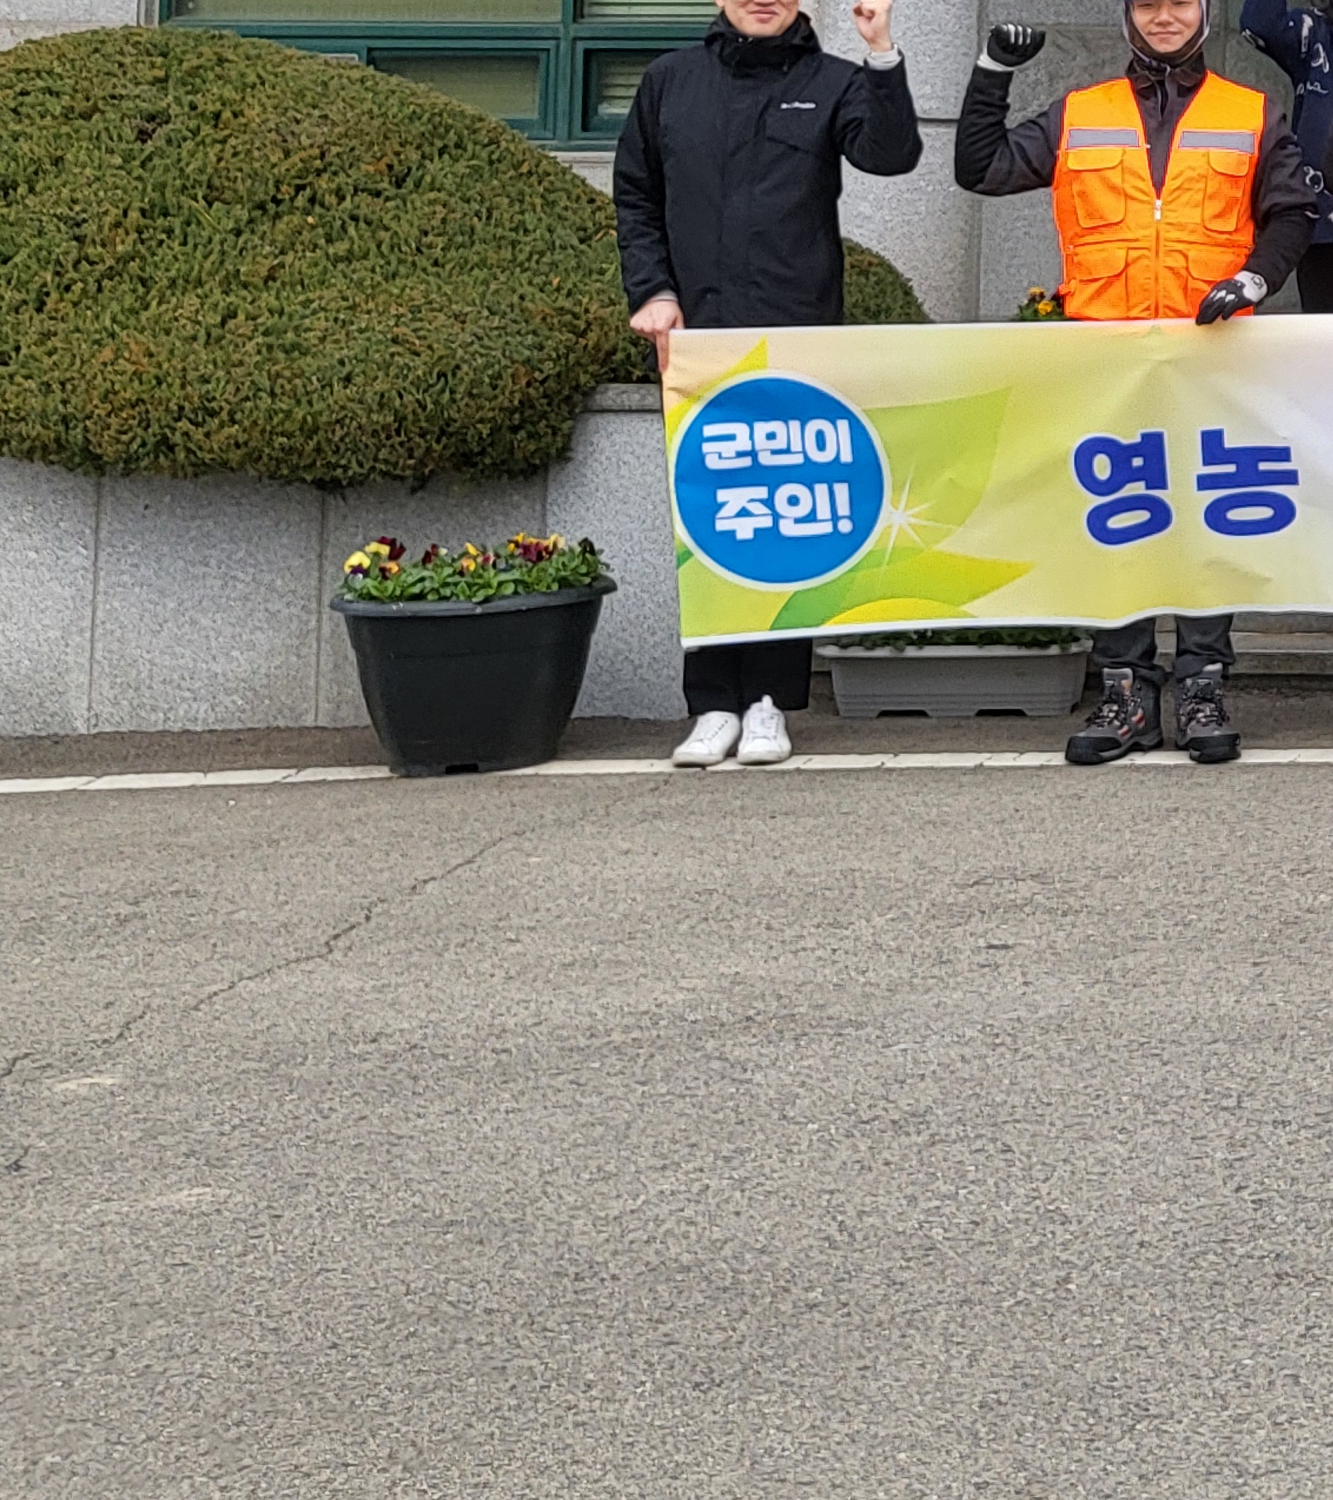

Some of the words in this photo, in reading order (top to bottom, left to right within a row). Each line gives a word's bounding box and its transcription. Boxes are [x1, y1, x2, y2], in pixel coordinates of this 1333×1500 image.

[702, 418, 853, 471] 군민이
[715, 483, 852, 540] 주인!
[1074, 429, 1299, 546] 영농
